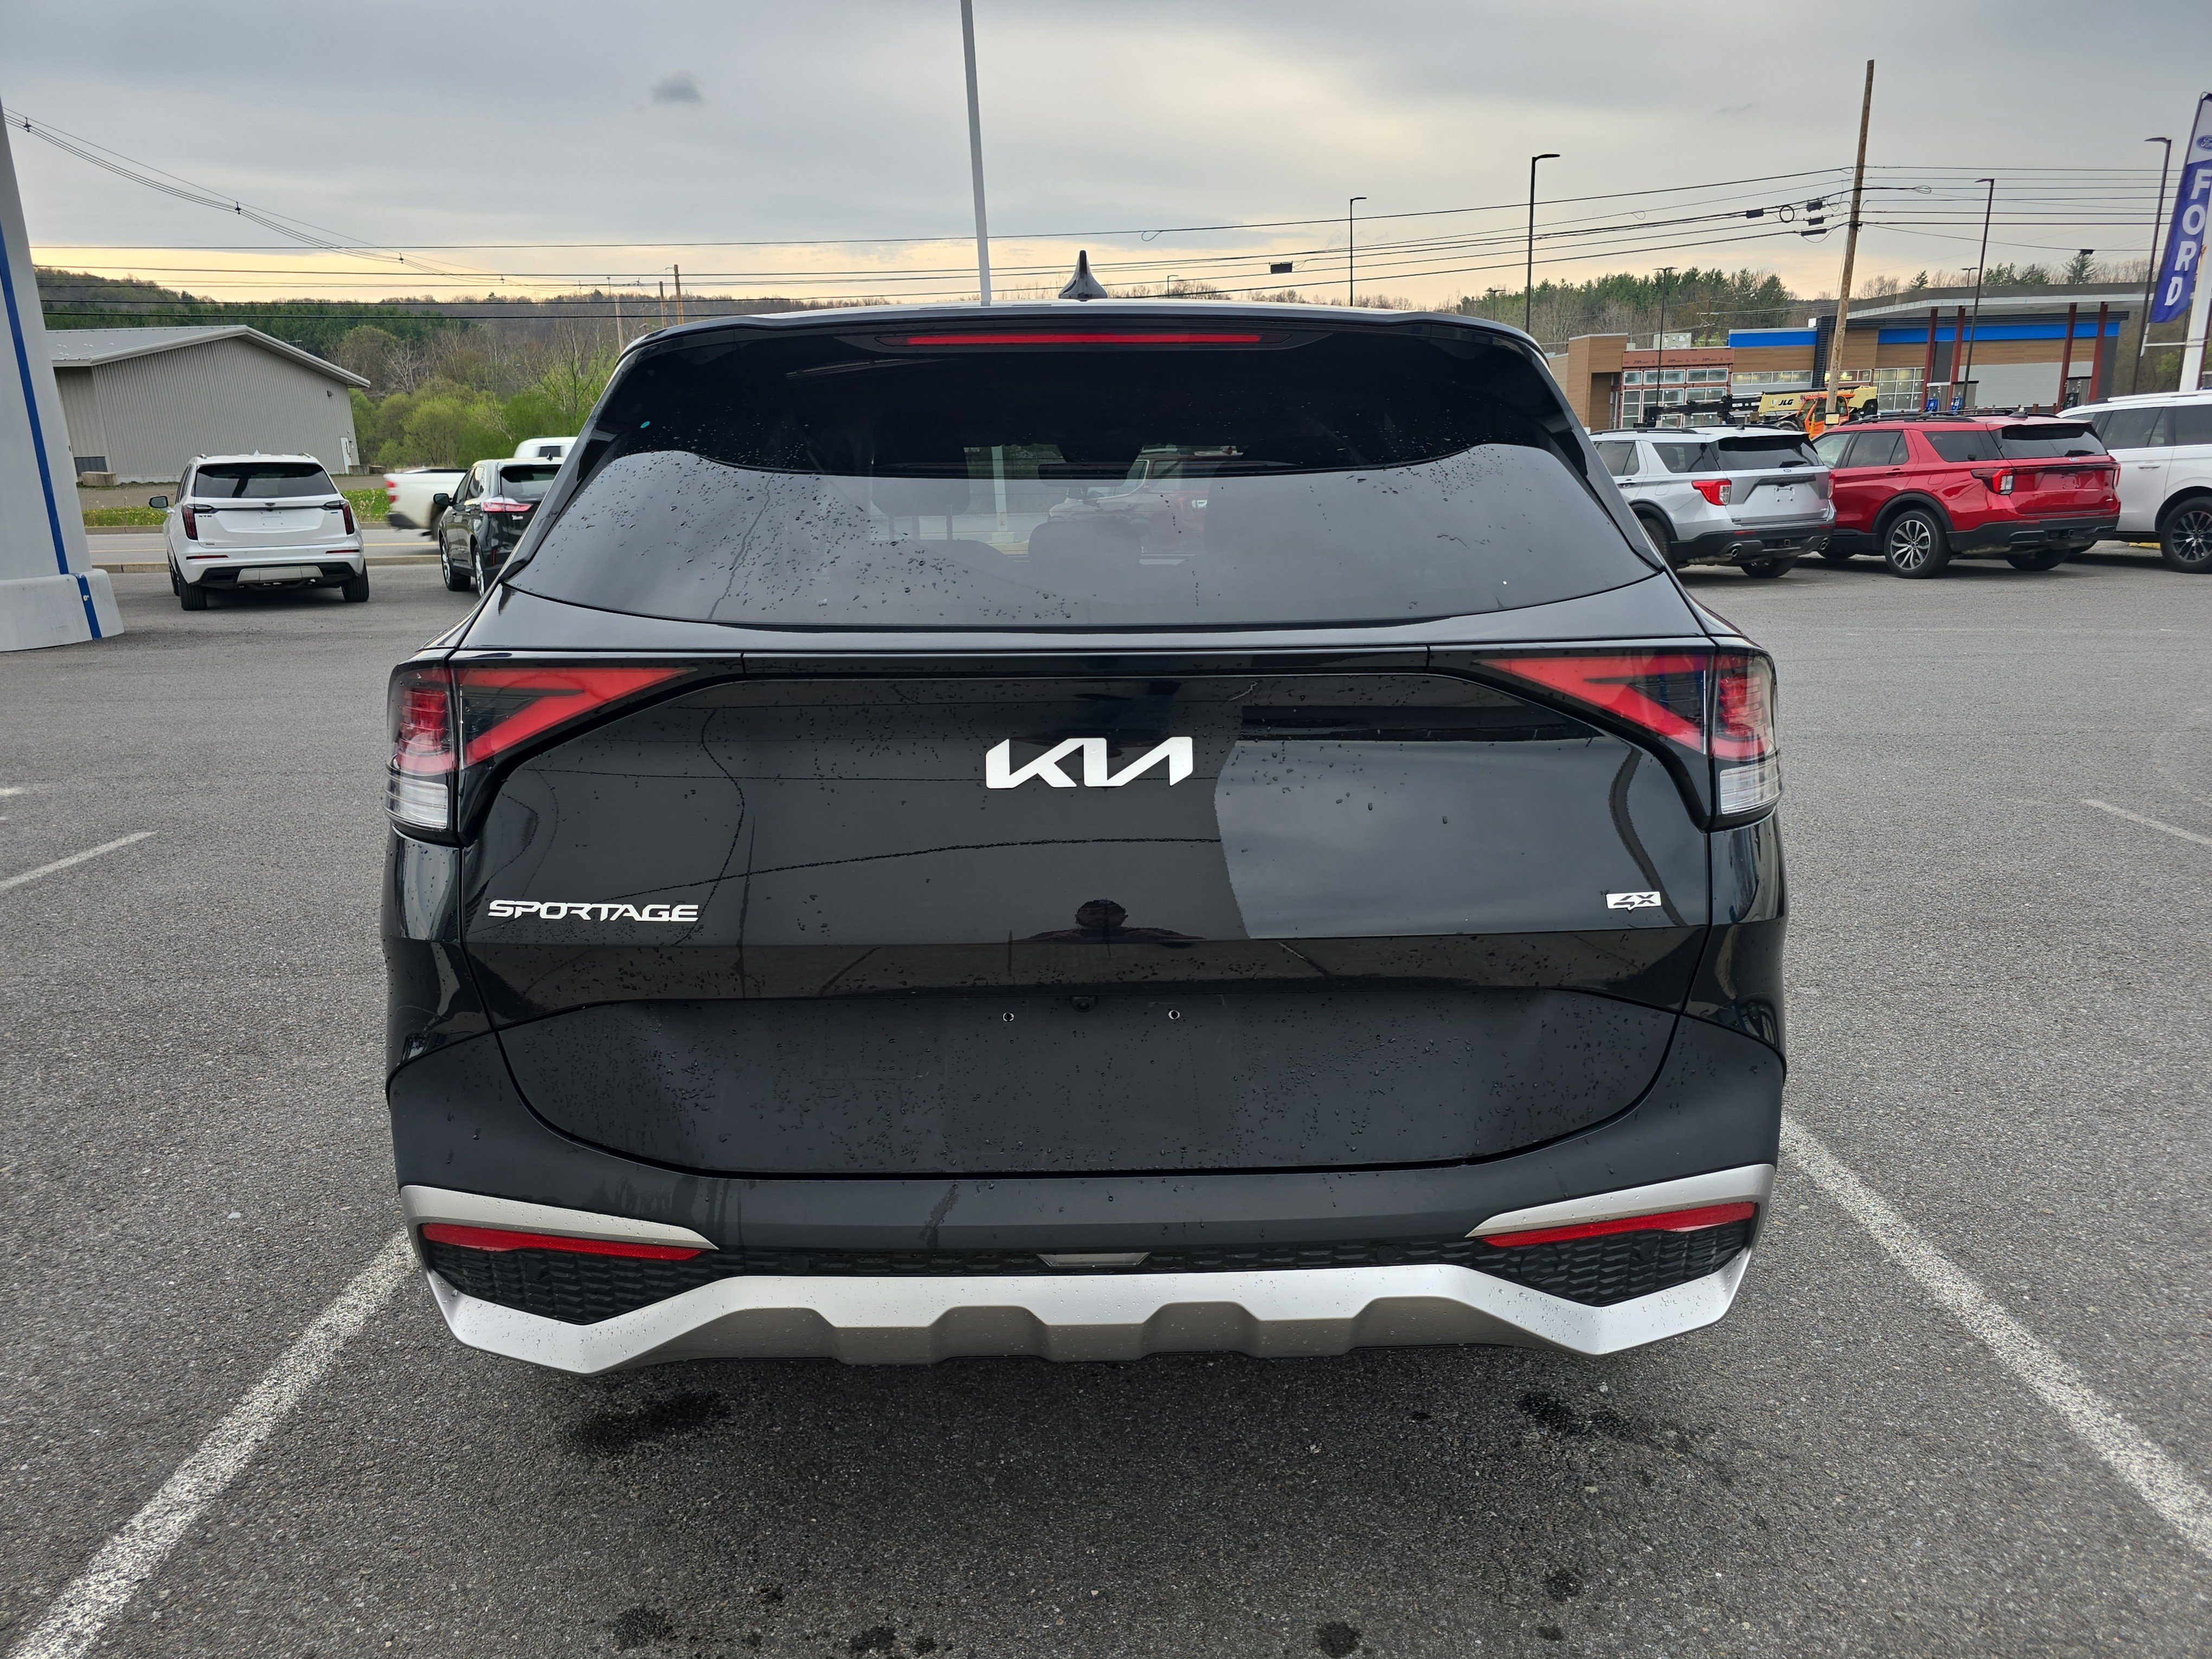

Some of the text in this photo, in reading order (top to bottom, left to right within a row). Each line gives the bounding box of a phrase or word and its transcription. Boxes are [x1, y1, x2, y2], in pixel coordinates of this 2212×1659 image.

[2164, 169, 2212, 306] FORD
[986, 736, 1193, 789] KIA
[487, 899, 699, 922] SPORTAGE
